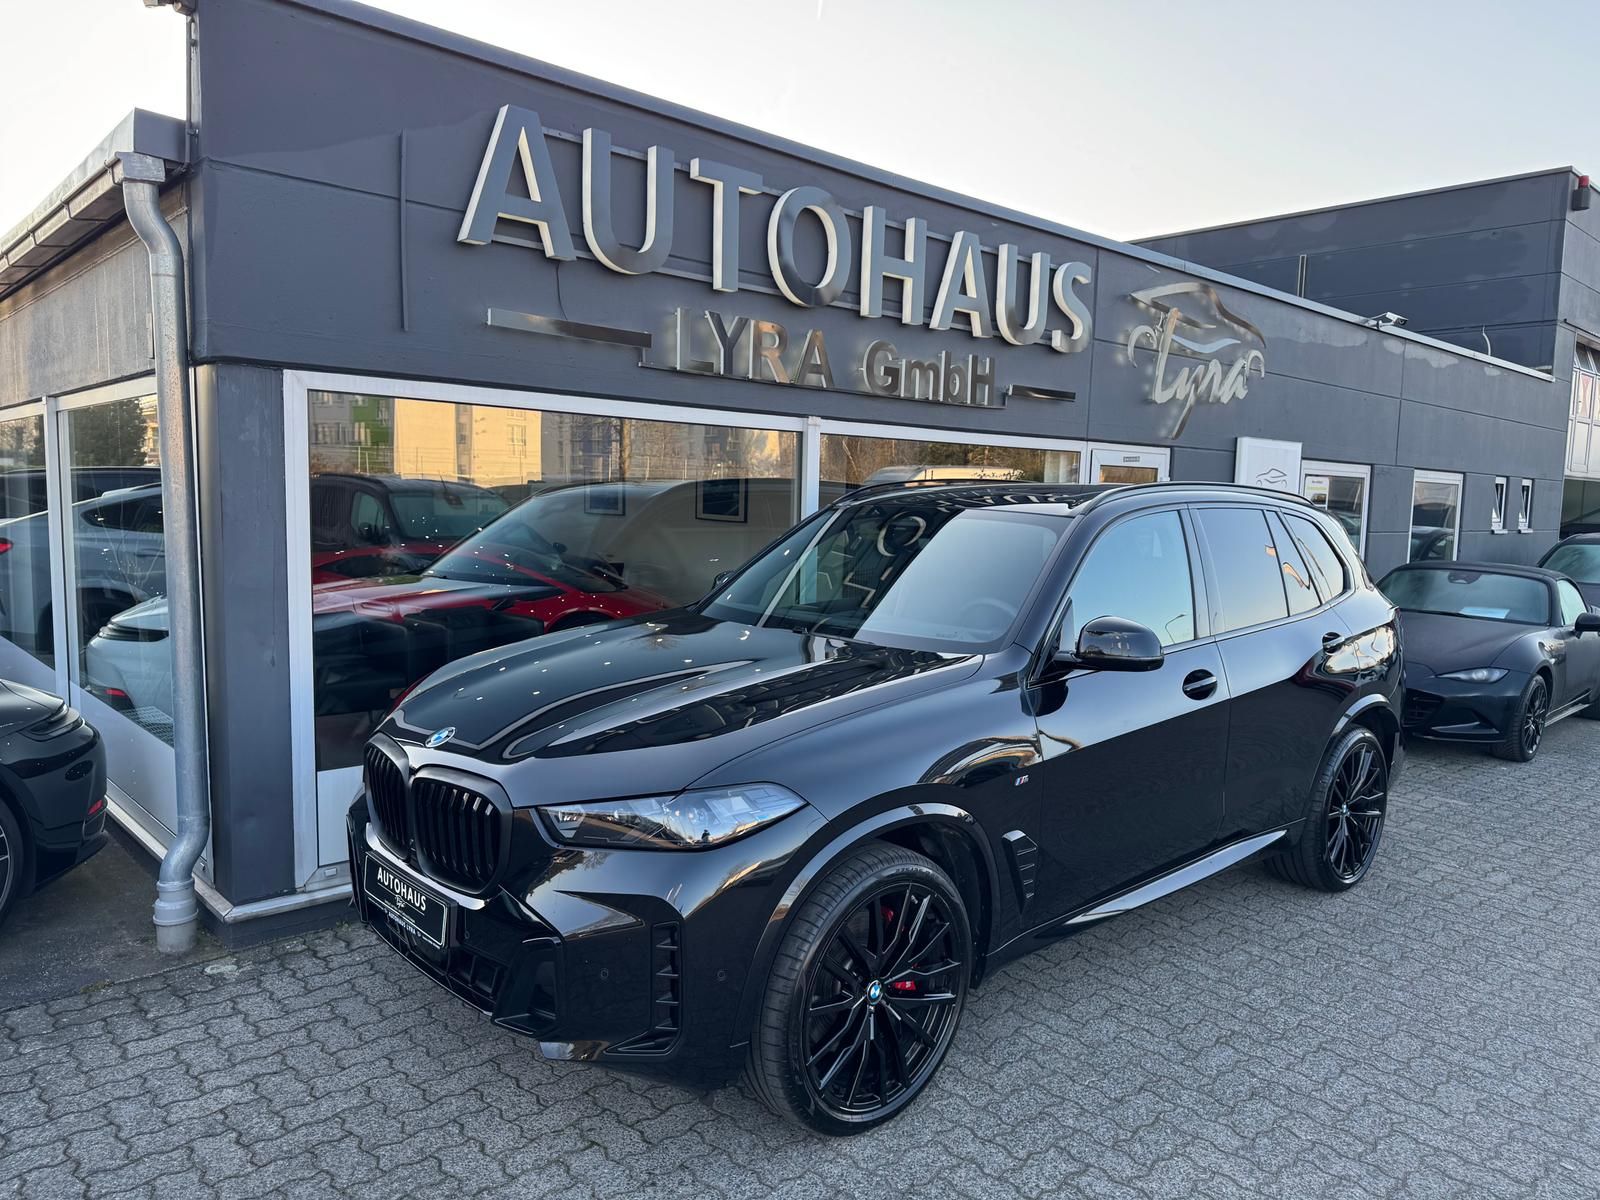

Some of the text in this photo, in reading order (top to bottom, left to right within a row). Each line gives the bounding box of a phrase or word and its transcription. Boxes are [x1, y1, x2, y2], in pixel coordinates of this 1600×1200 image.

[457, 103, 1093, 354] AUTOHAUS
[674, 307, 997, 406] LYRA GmbH
[377, 866, 427, 912] AUTOHAUS
